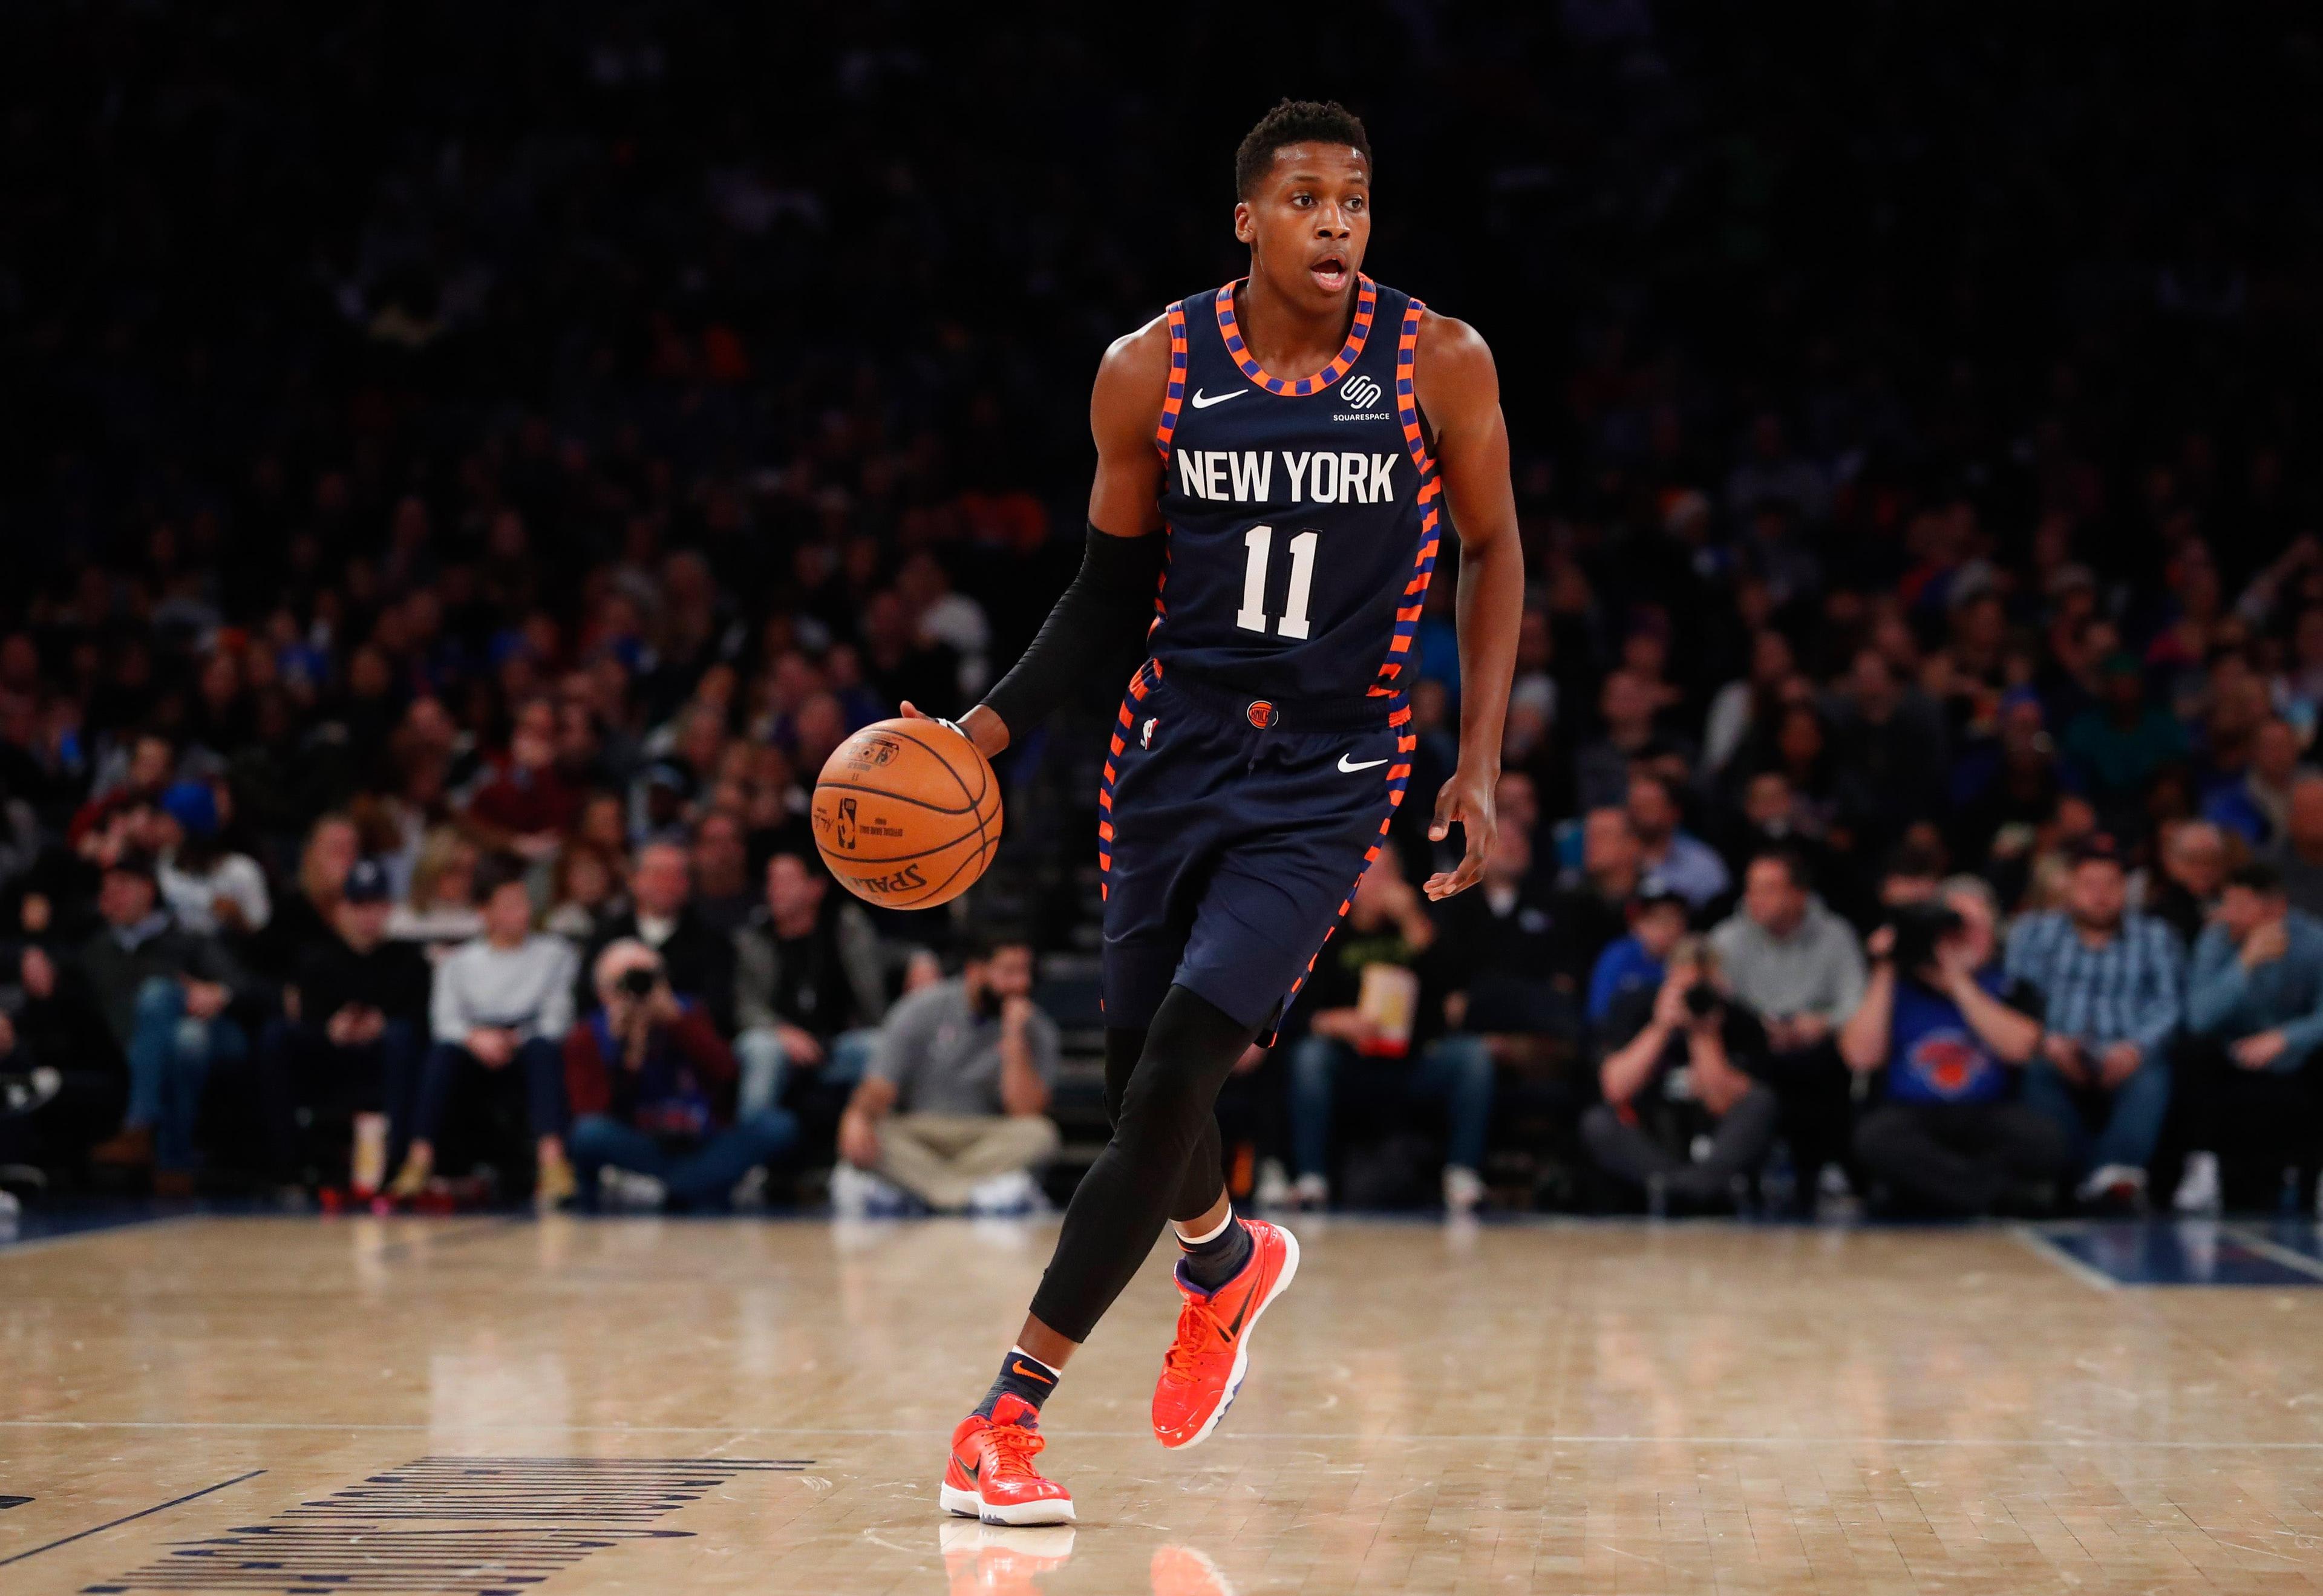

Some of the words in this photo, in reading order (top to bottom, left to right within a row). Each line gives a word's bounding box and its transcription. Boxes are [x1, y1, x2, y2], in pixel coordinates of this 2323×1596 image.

[1333, 413, 1390, 422] SQUARESPACE
[1177, 448, 1273, 502] NEW
[1282, 451, 1399, 504] YORK
[1236, 525, 1319, 640] 11
[852, 863, 927, 893] SPAL
